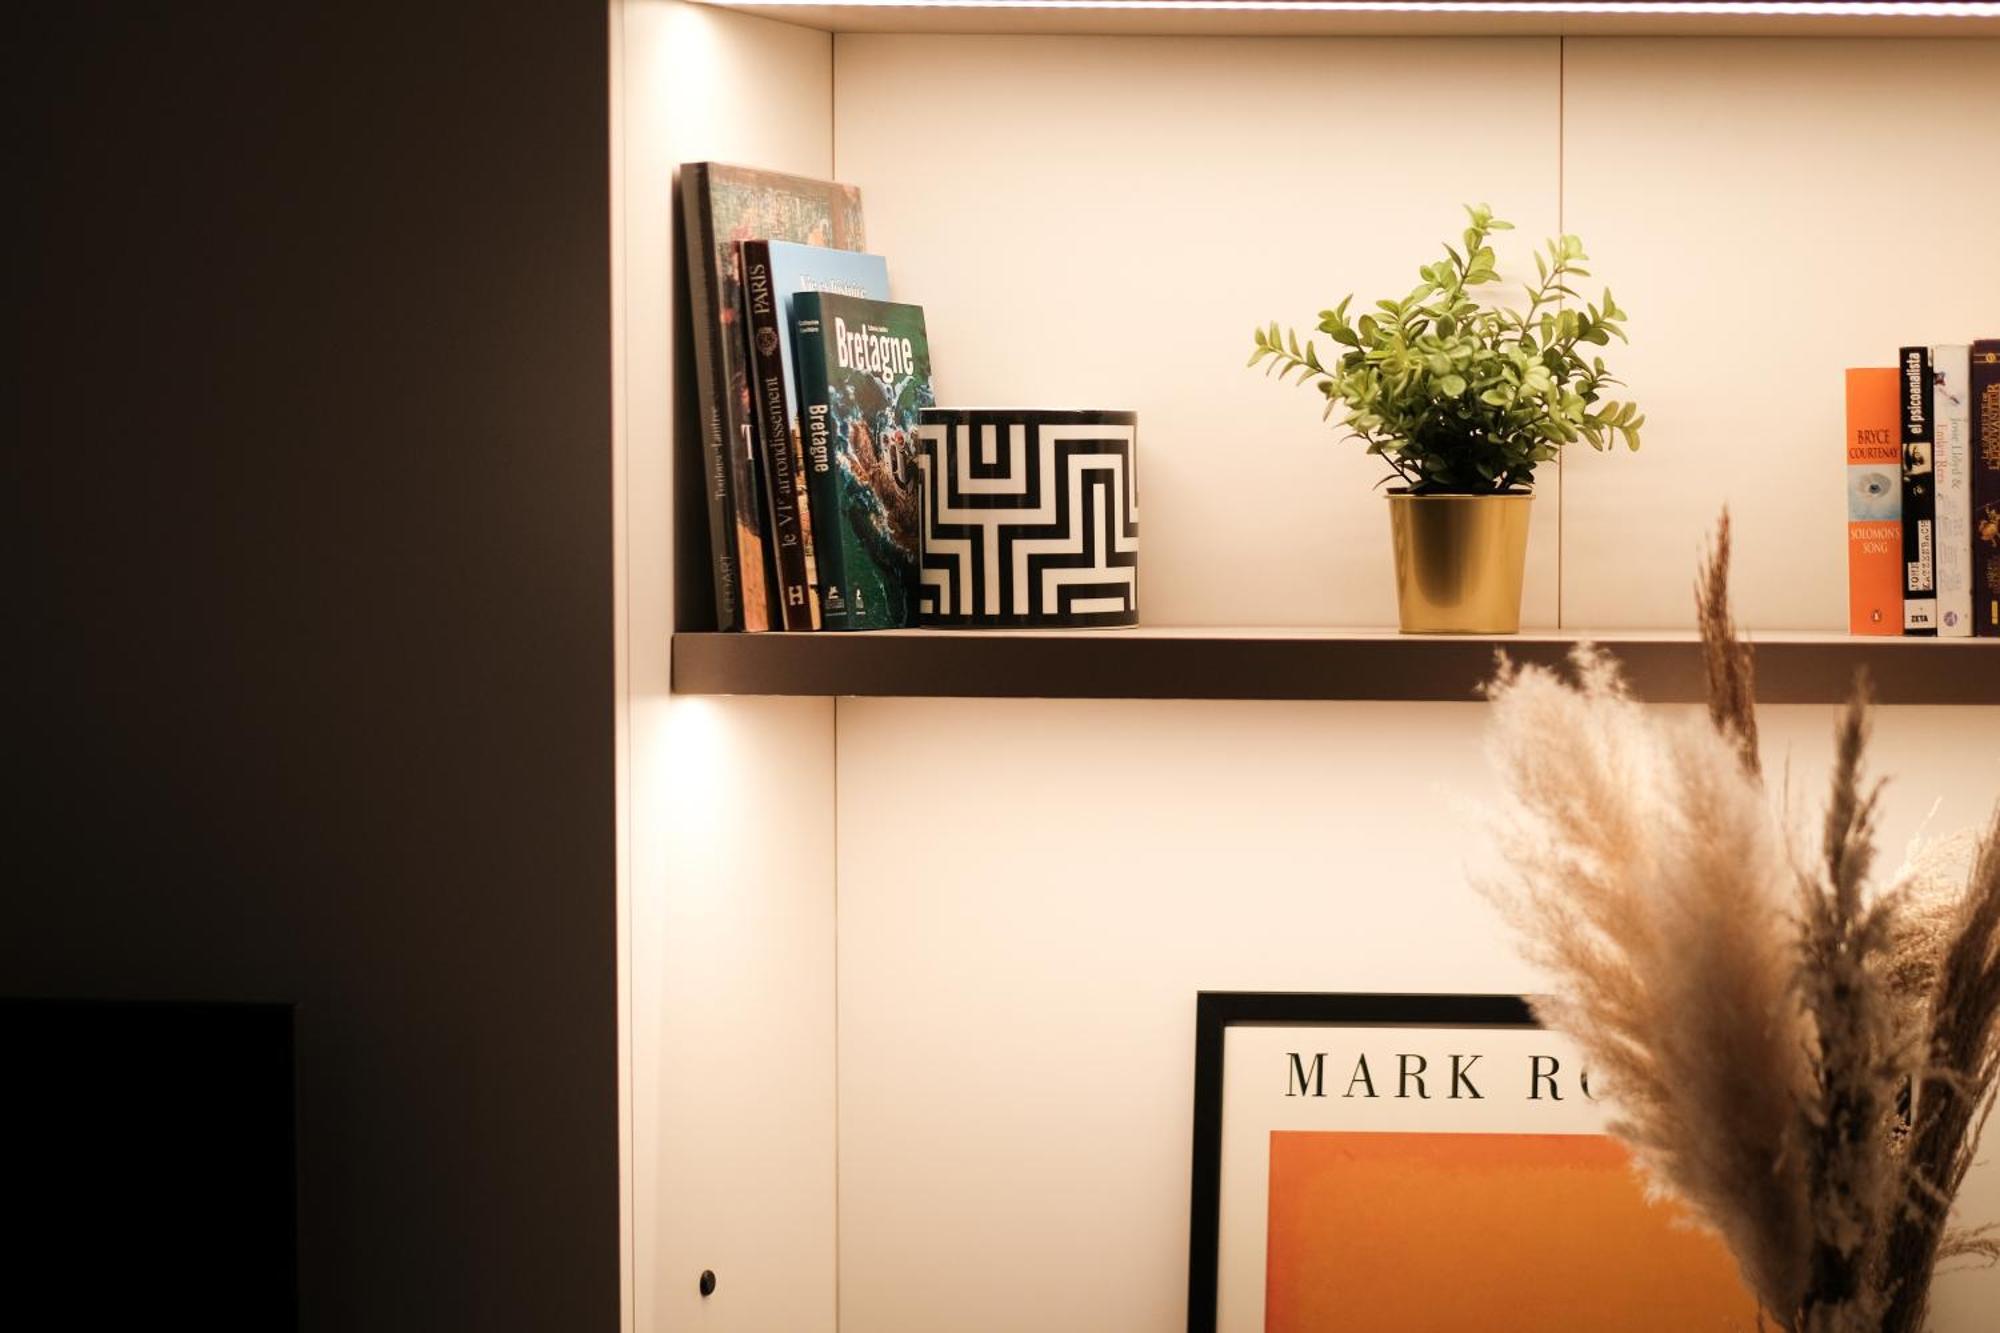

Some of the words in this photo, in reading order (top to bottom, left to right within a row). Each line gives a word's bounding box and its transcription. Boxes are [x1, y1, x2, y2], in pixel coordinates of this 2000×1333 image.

[754, 264, 770, 315] PARIS
[835, 316, 914, 383] Bretagne
[1907, 353, 1925, 422] psicoanalista
[766, 376, 791, 495] arrondissement
[809, 404, 829, 473] Bretagne
[1857, 429, 1890, 445] BRYCE
[1907, 424, 1923, 434] el
[1849, 447, 1897, 460] COURTENAY
[782, 532, 797, 547] le
[1863, 542, 1888, 554] SONG
[1285, 1052, 1485, 1100] MARK
